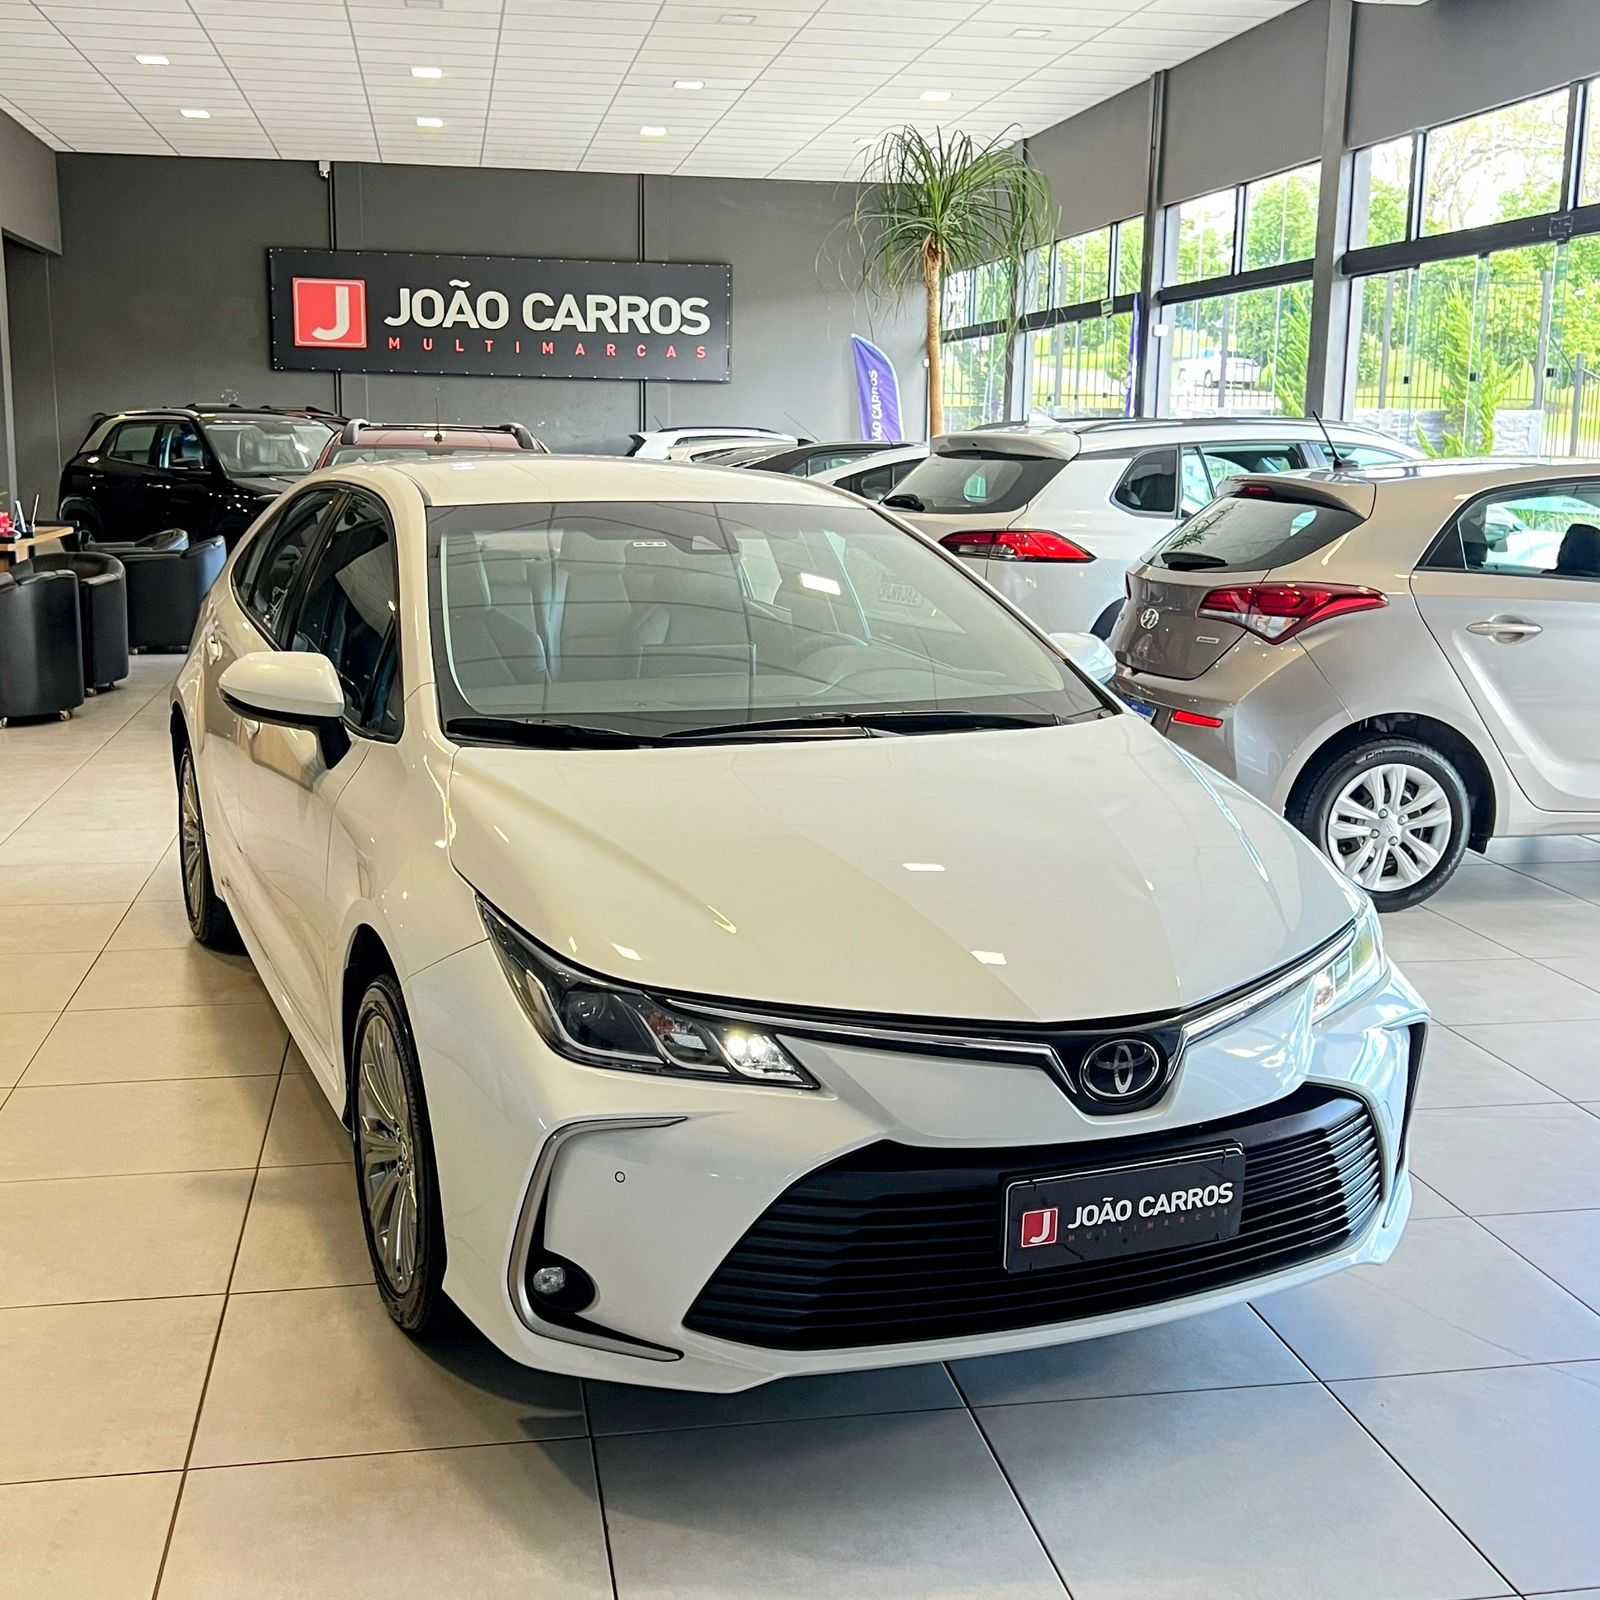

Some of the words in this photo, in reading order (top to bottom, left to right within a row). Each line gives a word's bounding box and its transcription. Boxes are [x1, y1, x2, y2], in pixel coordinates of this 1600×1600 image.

[311, 285, 350, 341] J
[383, 278, 510, 331] JOÃO
[522, 292, 712, 336] CARROS
[388, 337, 706, 359] MULTIMARCAS
[1029, 1211, 1050, 1244] J
[1066, 1196, 1132, 1229] JOÃO
[1138, 1182, 1234, 1218] CARROS
